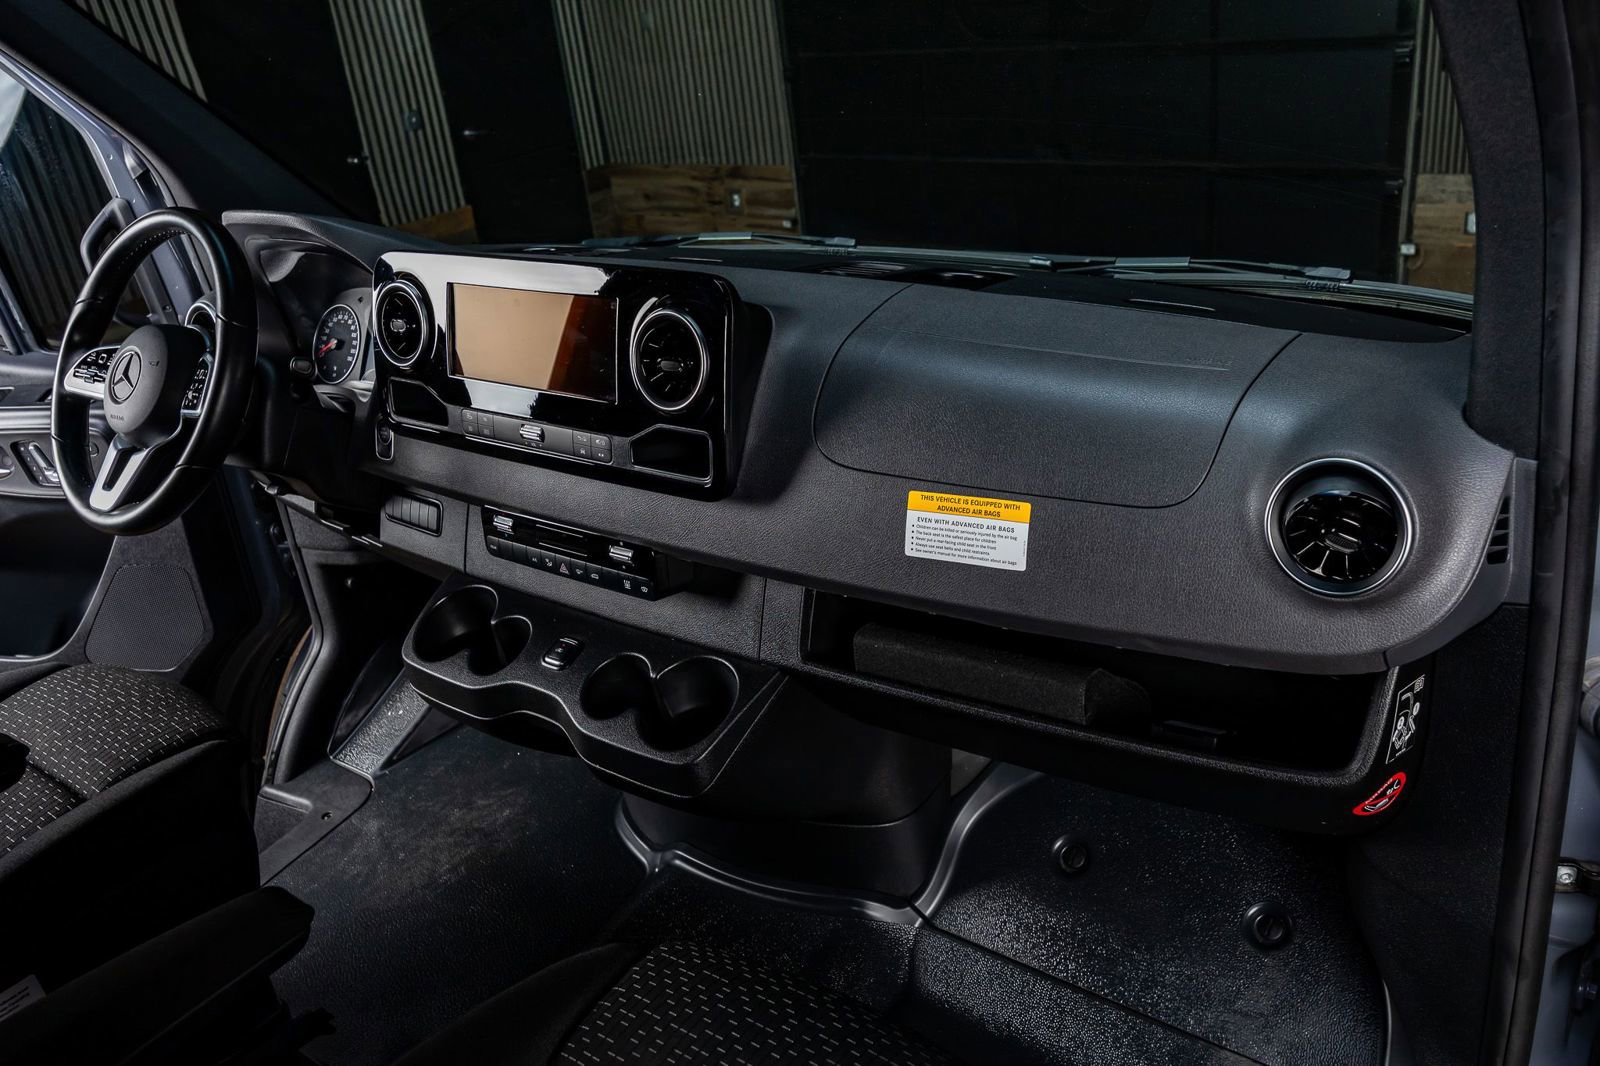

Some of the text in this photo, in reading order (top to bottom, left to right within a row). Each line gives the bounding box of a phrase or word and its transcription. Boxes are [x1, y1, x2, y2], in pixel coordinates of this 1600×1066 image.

[971, 500, 1002, 508] EQUIPPED
[937, 505, 970, 514] ADVANCED
[951, 521, 984, 529] ADVANCED
